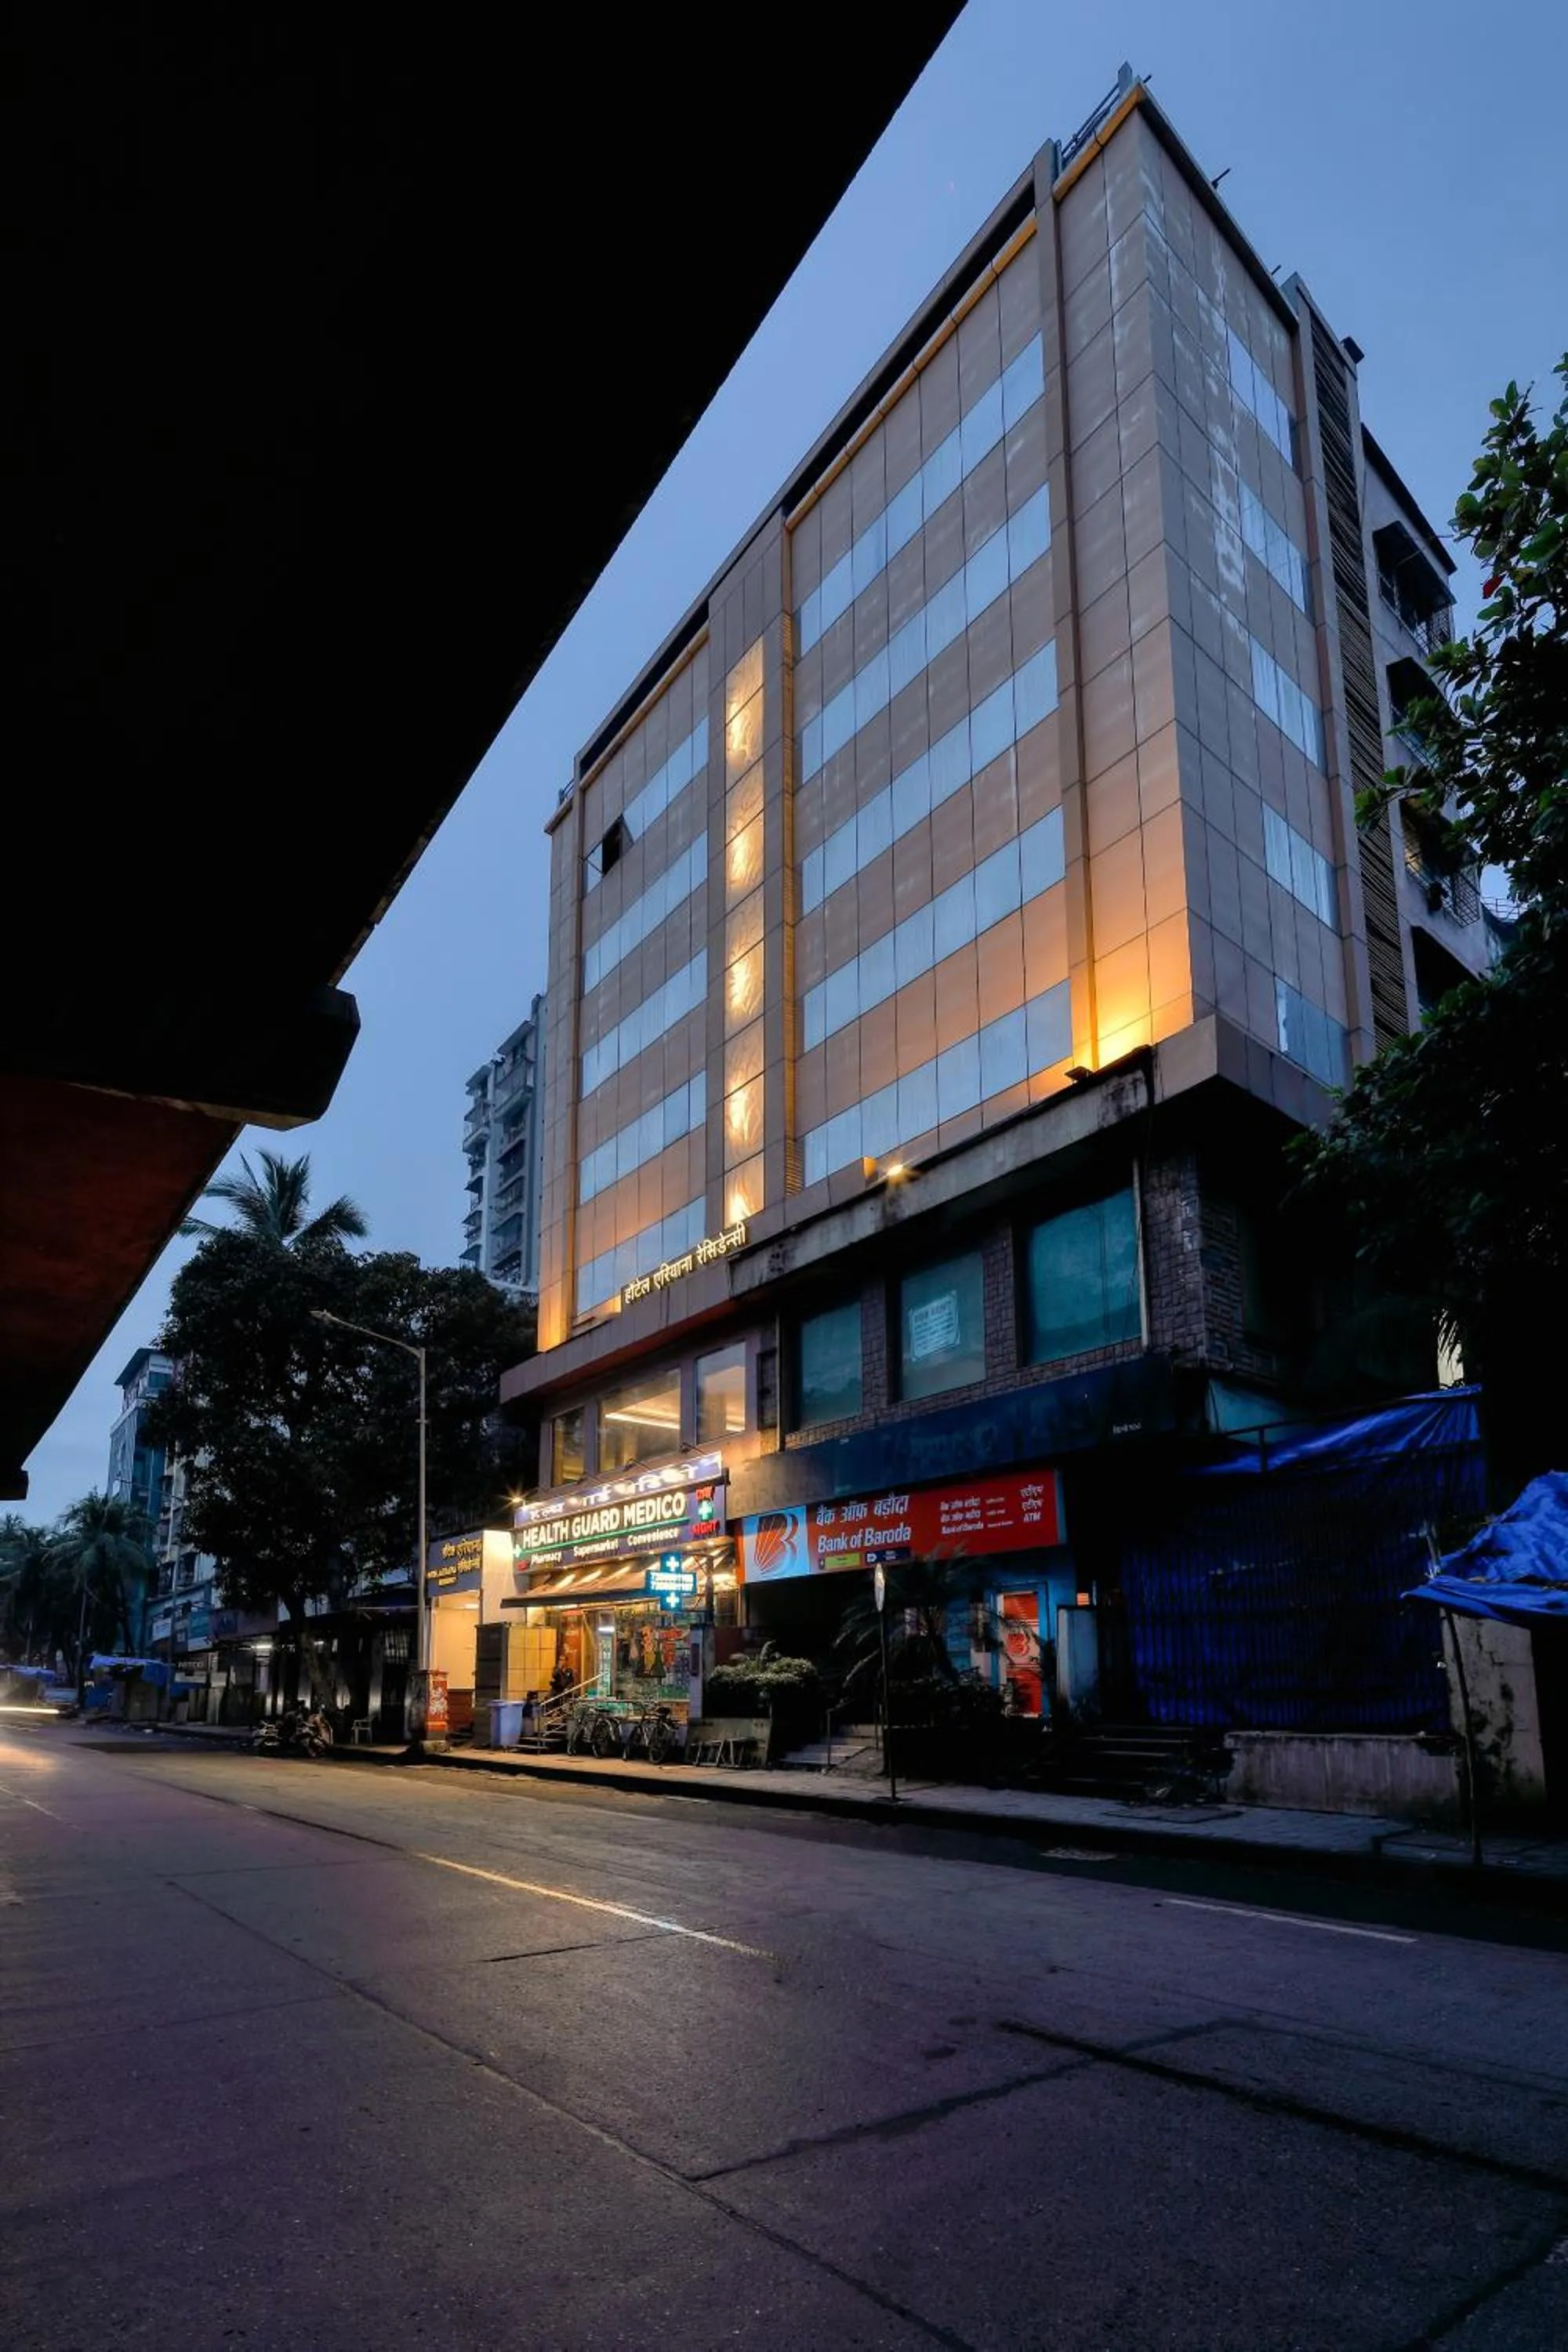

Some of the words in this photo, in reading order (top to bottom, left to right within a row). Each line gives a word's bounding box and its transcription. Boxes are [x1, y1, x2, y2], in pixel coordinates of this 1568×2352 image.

[653, 1254, 694, 1290] एरियाना
[522, 1518, 570, 1550] HEALTH
[572, 1507, 621, 1538] GUARD
[623, 1491, 687, 1528] MEDICO
[1023, 1511, 1042, 1523] ATM
[627, 1527, 680, 1547] Convenience
[817, 1531, 848, 1554] Bank
[850, 1528, 864, 1549] of
[863, 1521, 912, 1547] Baroda
